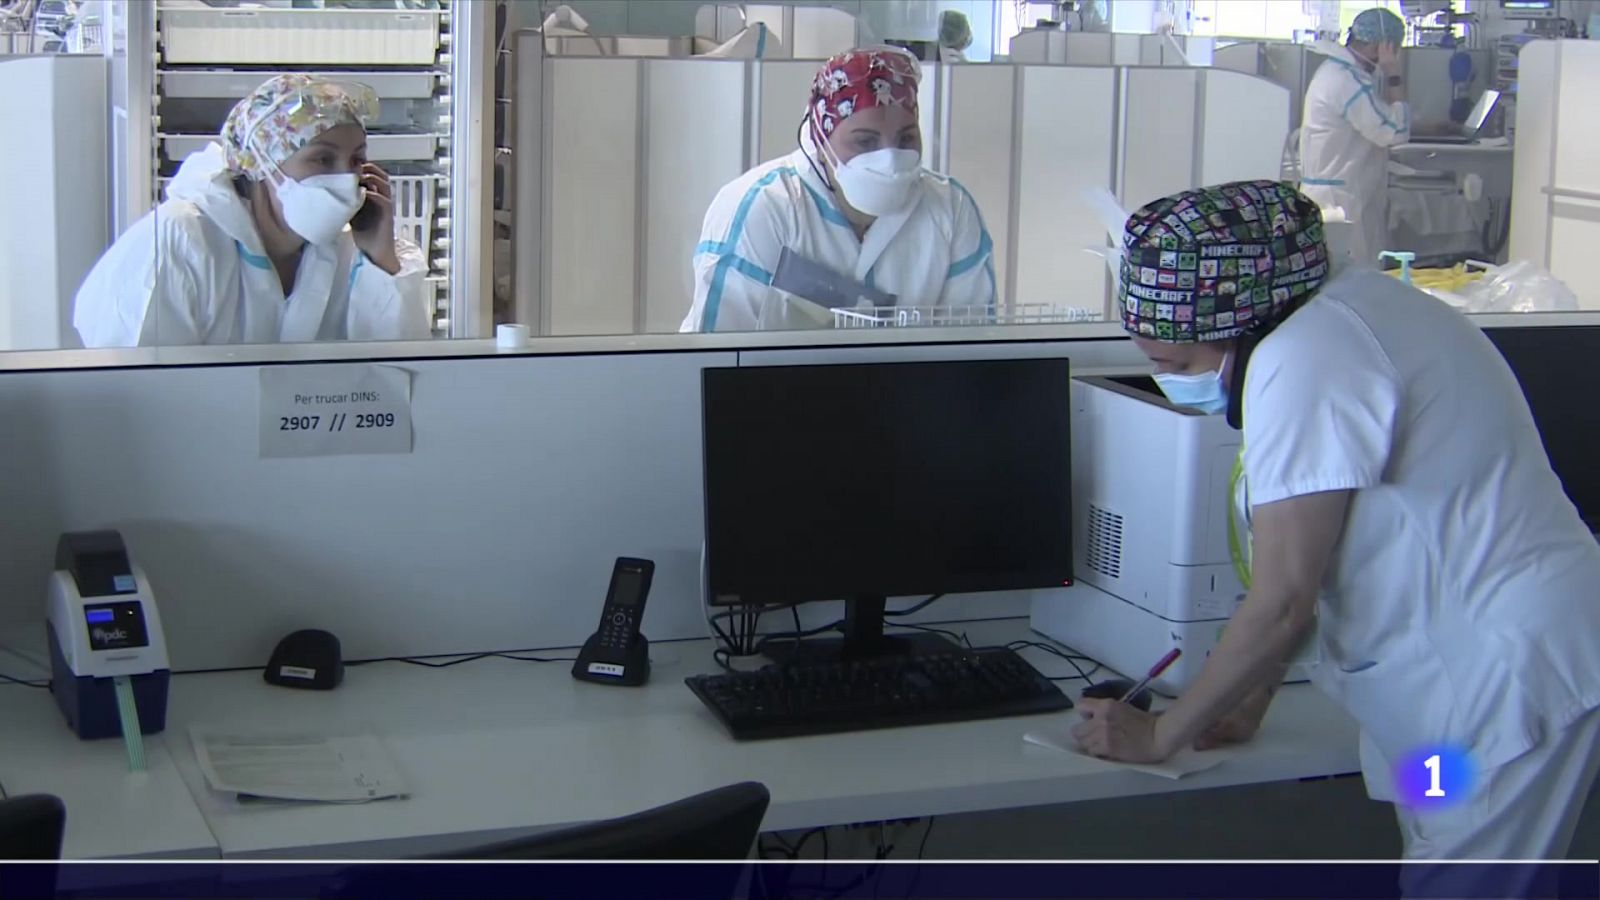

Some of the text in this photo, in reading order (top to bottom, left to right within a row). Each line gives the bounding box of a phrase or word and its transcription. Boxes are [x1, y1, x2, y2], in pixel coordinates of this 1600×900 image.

[295, 391, 380, 404] Per trucar DINS:
[280, 413, 395, 431] 2907 // 2909
